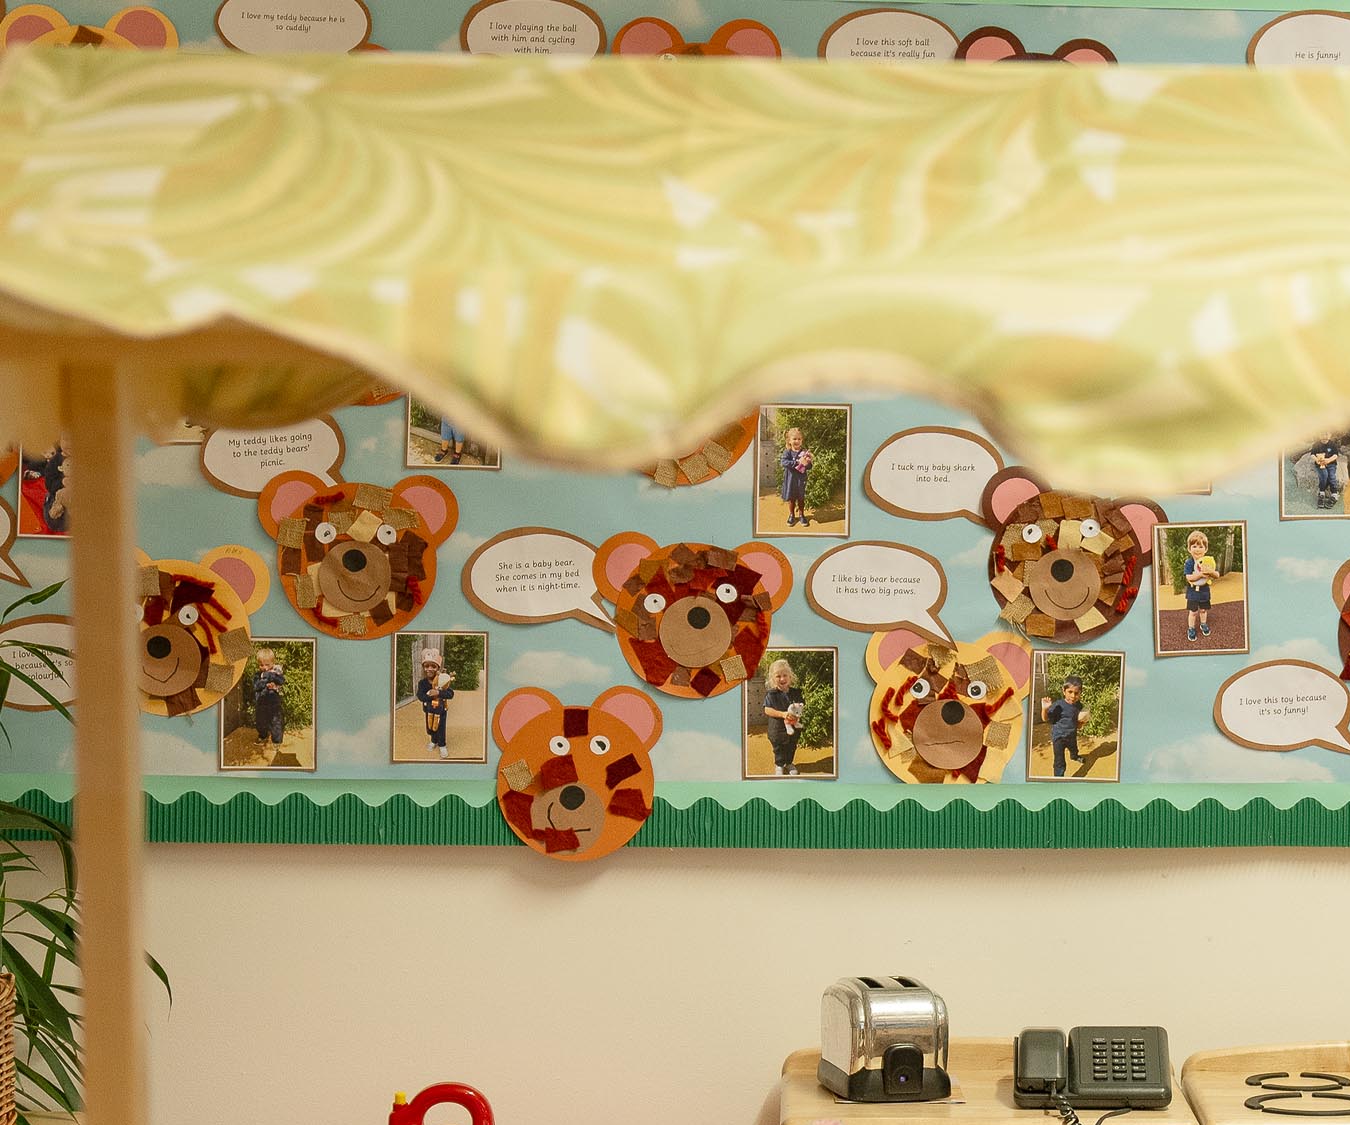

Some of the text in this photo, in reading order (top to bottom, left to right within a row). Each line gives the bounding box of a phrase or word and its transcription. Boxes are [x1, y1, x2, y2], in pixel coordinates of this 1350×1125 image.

[247, 12, 261, 20] love
[277, 14, 297, 22] teddy
[329, 15, 338, 23] he
[286, 24, 311, 33] cuddly!
[495, 22, 512, 30] love
[514, 22, 544, 33] playing
[546, 24, 560, 32] the
[562, 24, 577, 32] ball
[490, 34, 576, 46] with him and cycling
[862, 38, 879, 46] love
[881, 38, 896, 46] this
[898, 38, 913, 48] soft
[915, 38, 930, 46] ball
[514, 46, 532, 54] with
[850, 49, 936, 59] because it's really fun
[1295, 51, 1341, 60] He is funny!
[228, 433, 313, 448] My teddy likes going
[244, 448, 258, 457] the
[260, 447, 283, 456] teddy
[286, 444, 310, 453] bears'
[260, 459, 285, 470] picnic.
[897, 463, 914, 471] tuck
[932, 464, 951, 472] baby
[953, 464, 976, 472] shark
[498, 562, 513, 570] She
[515, 561, 522, 569] is
[532, 560, 552, 569] baby
[555, 559, 575, 567] bear.
[495, 573, 510, 582] She
[549, 572, 562, 580] my
[565, 569, 580, 578] bed
[838, 575, 852, 583] like
[854, 575, 867, 584] big
[870, 575, 888, 583] bear
[890, 576, 921, 584] because
[495, 584, 518, 593] when
[520, 584, 526, 592] it
[538, 582, 580, 592] night-time.
[836, 586, 842, 594] it
[844, 586, 858, 594] has
[878, 586, 891, 596] big
[893, 588, 916, 596] paws.
[15, 662, 47, 670] because
[1264, 696, 1279, 704] this
[1281, 697, 1294, 705] toy
[1296, 694, 1327, 702] because
[1259, 708, 1271, 716] it's
[1284, 706, 1308, 716] funny!
